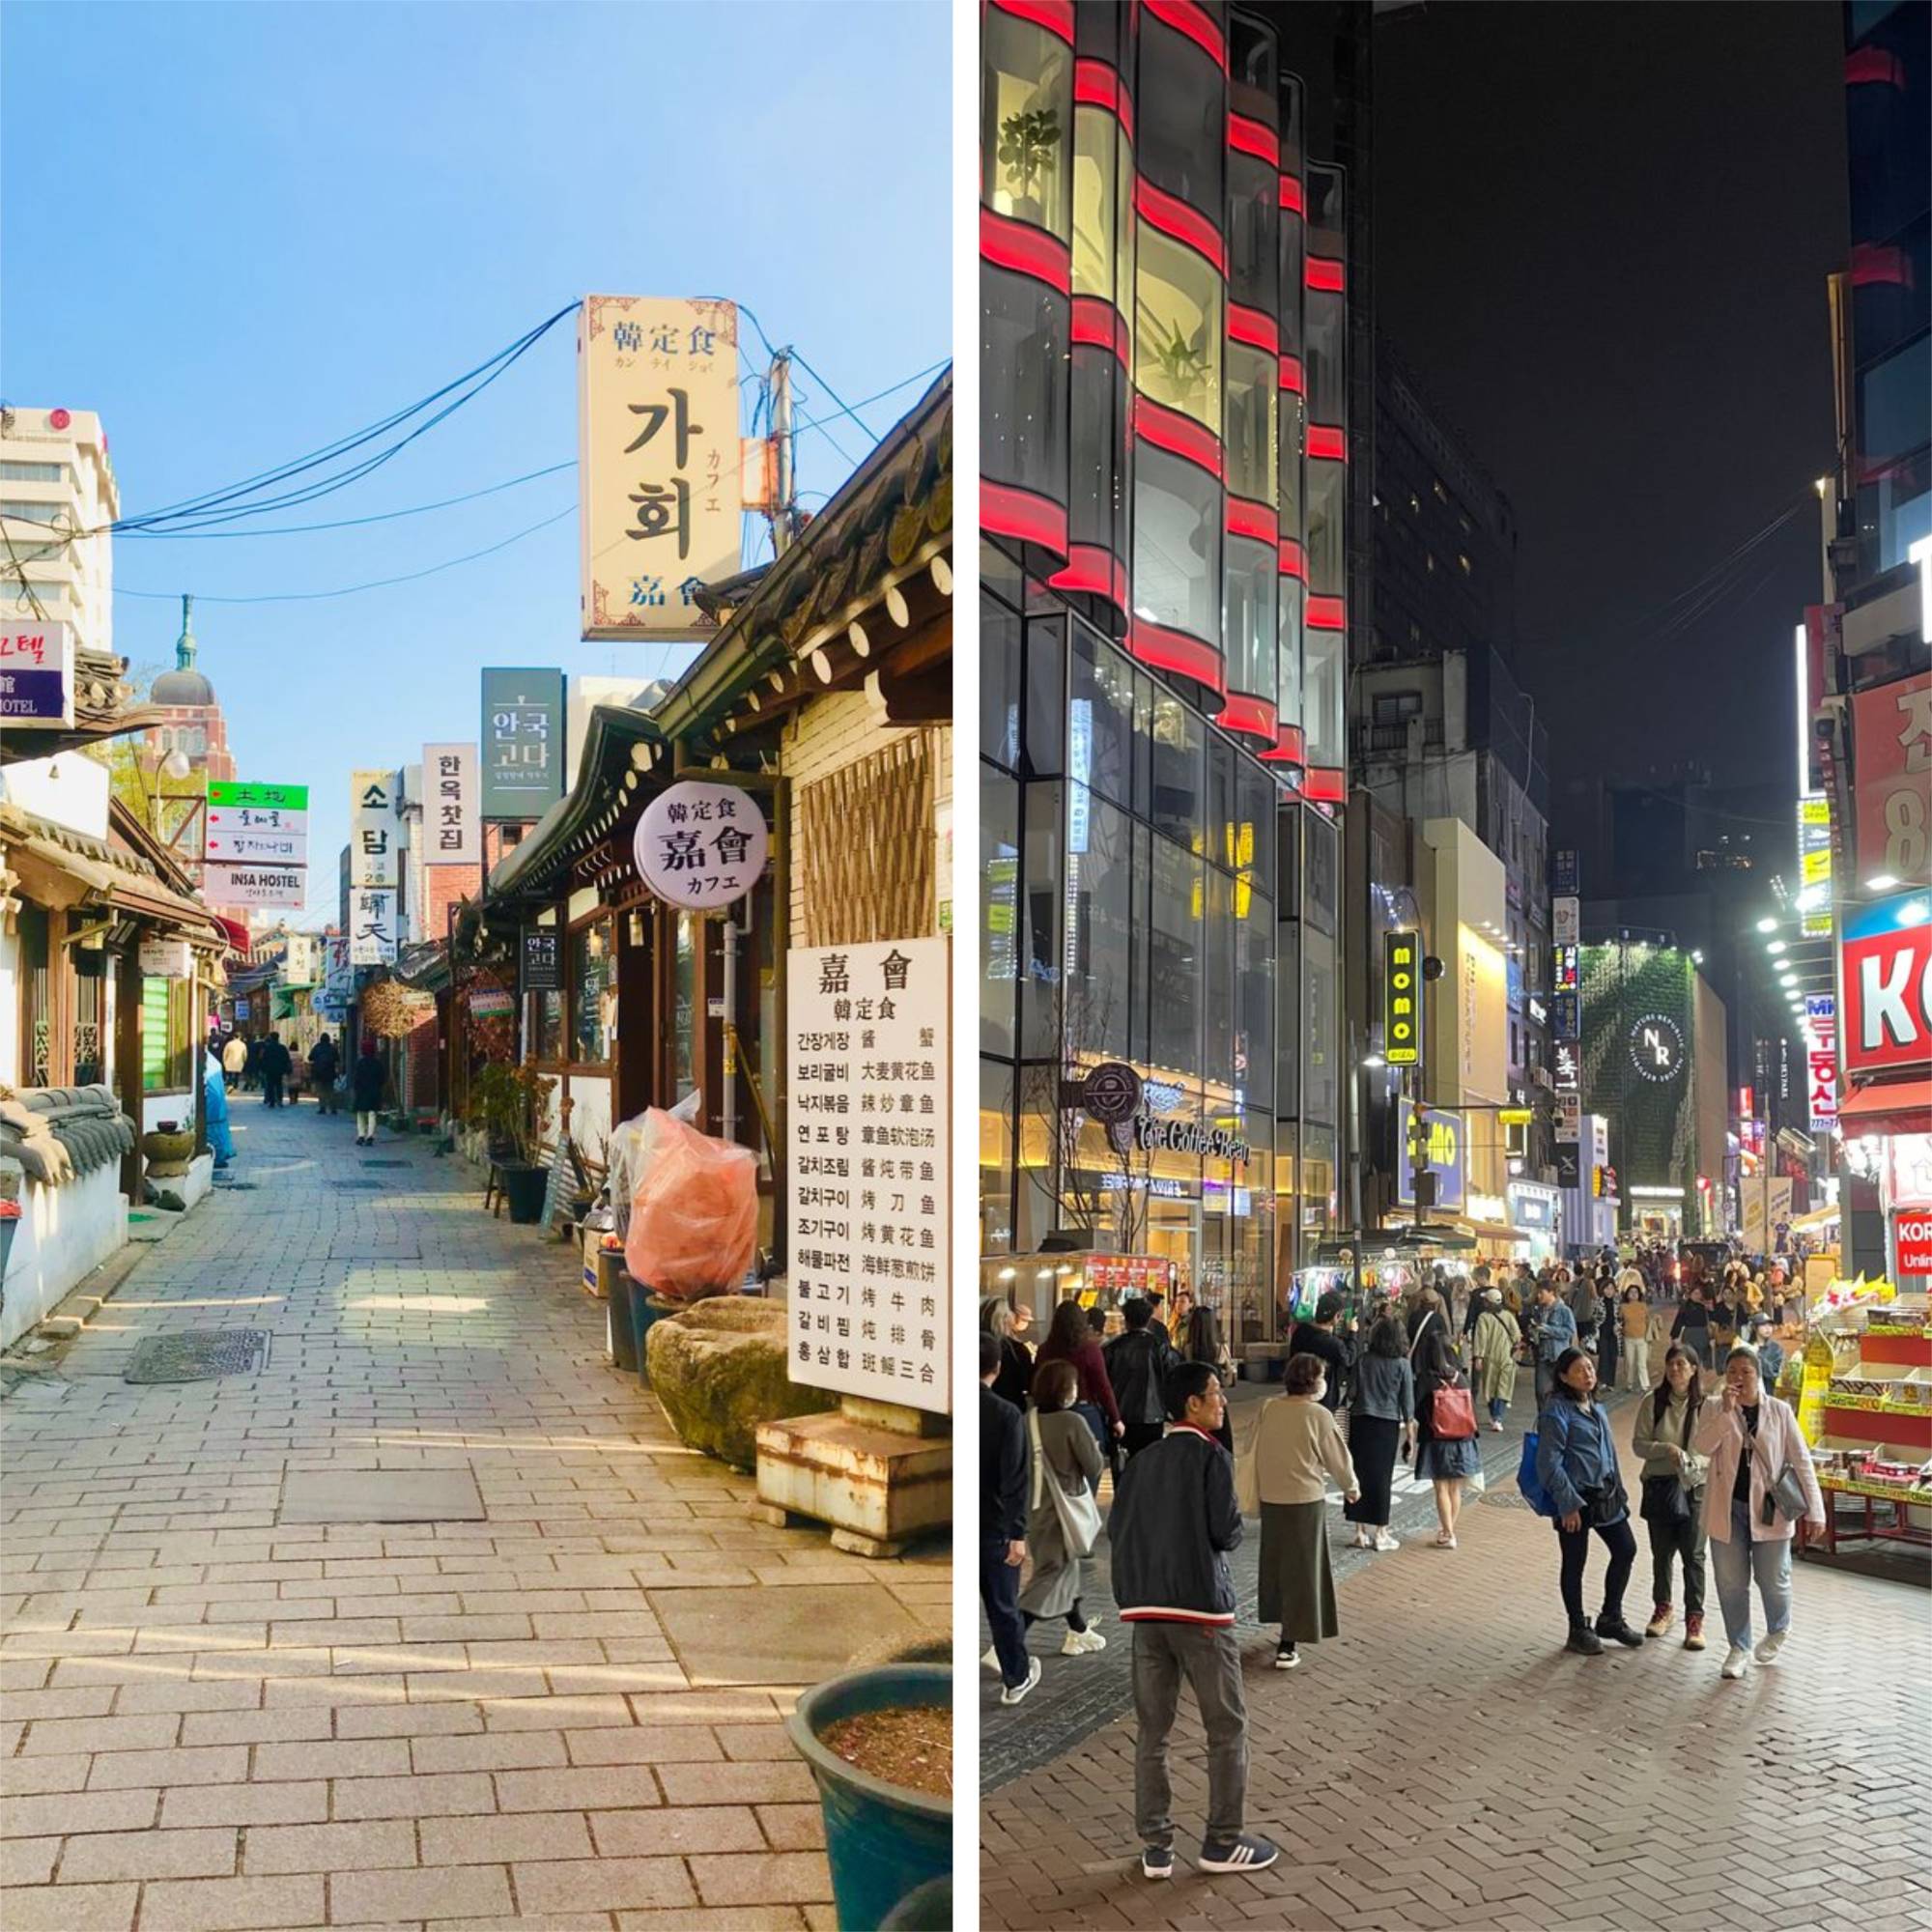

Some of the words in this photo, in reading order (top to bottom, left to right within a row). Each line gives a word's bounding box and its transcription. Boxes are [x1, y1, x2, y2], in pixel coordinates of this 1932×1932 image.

[612, 322, 717, 356] 韓定食
[624, 387, 703, 560] 가회
[705, 449, 722, 512] カフェ
[0, 698, 38, 714] OTEL
[493, 712, 550, 740] 안국
[493, 743, 550, 769] 고다
[440, 755, 463, 850] 한옥찻집
[667, 798, 736, 823] 韓定食
[361, 785, 389, 855] 소담
[1885, 789, 1932, 875] 8
[658, 826, 753, 870] 嘉會
[231, 872, 256, 886] INSA
[259, 874, 300, 888] HOSTEL
[687, 874, 740, 895] カフェ
[819, 949, 912, 994] 嘉會
[834, 996, 896, 1022] 韓定食
[1861, 948, 1932, 1052] K
[798, 1032, 850, 1052] 간장게장
[797, 1063, 849, 1082] 보리굴비
[862, 1061, 935, 1081] 大麦黄花鱼
[797, 1094, 850, 1114] 낙지볶음
[797, 1124, 850, 1146] 연포탕
[1138, 1115, 1167, 1151] The
[1169, 1121, 1214, 1155] Coffee
[1216, 1130, 1252, 1165] Bean
[798, 1155, 849, 1178] 갈치조림
[798, 1186, 849, 1208] 갈치구이
[798, 1218, 849, 1240] 조기구이
[862, 1222, 935, 1249] 烤黄花鱼
[798, 1248, 850, 1273] 해물파전
[797, 1279, 849, 1305] 불고기
[798, 1311, 850, 1338] 갈비찜
